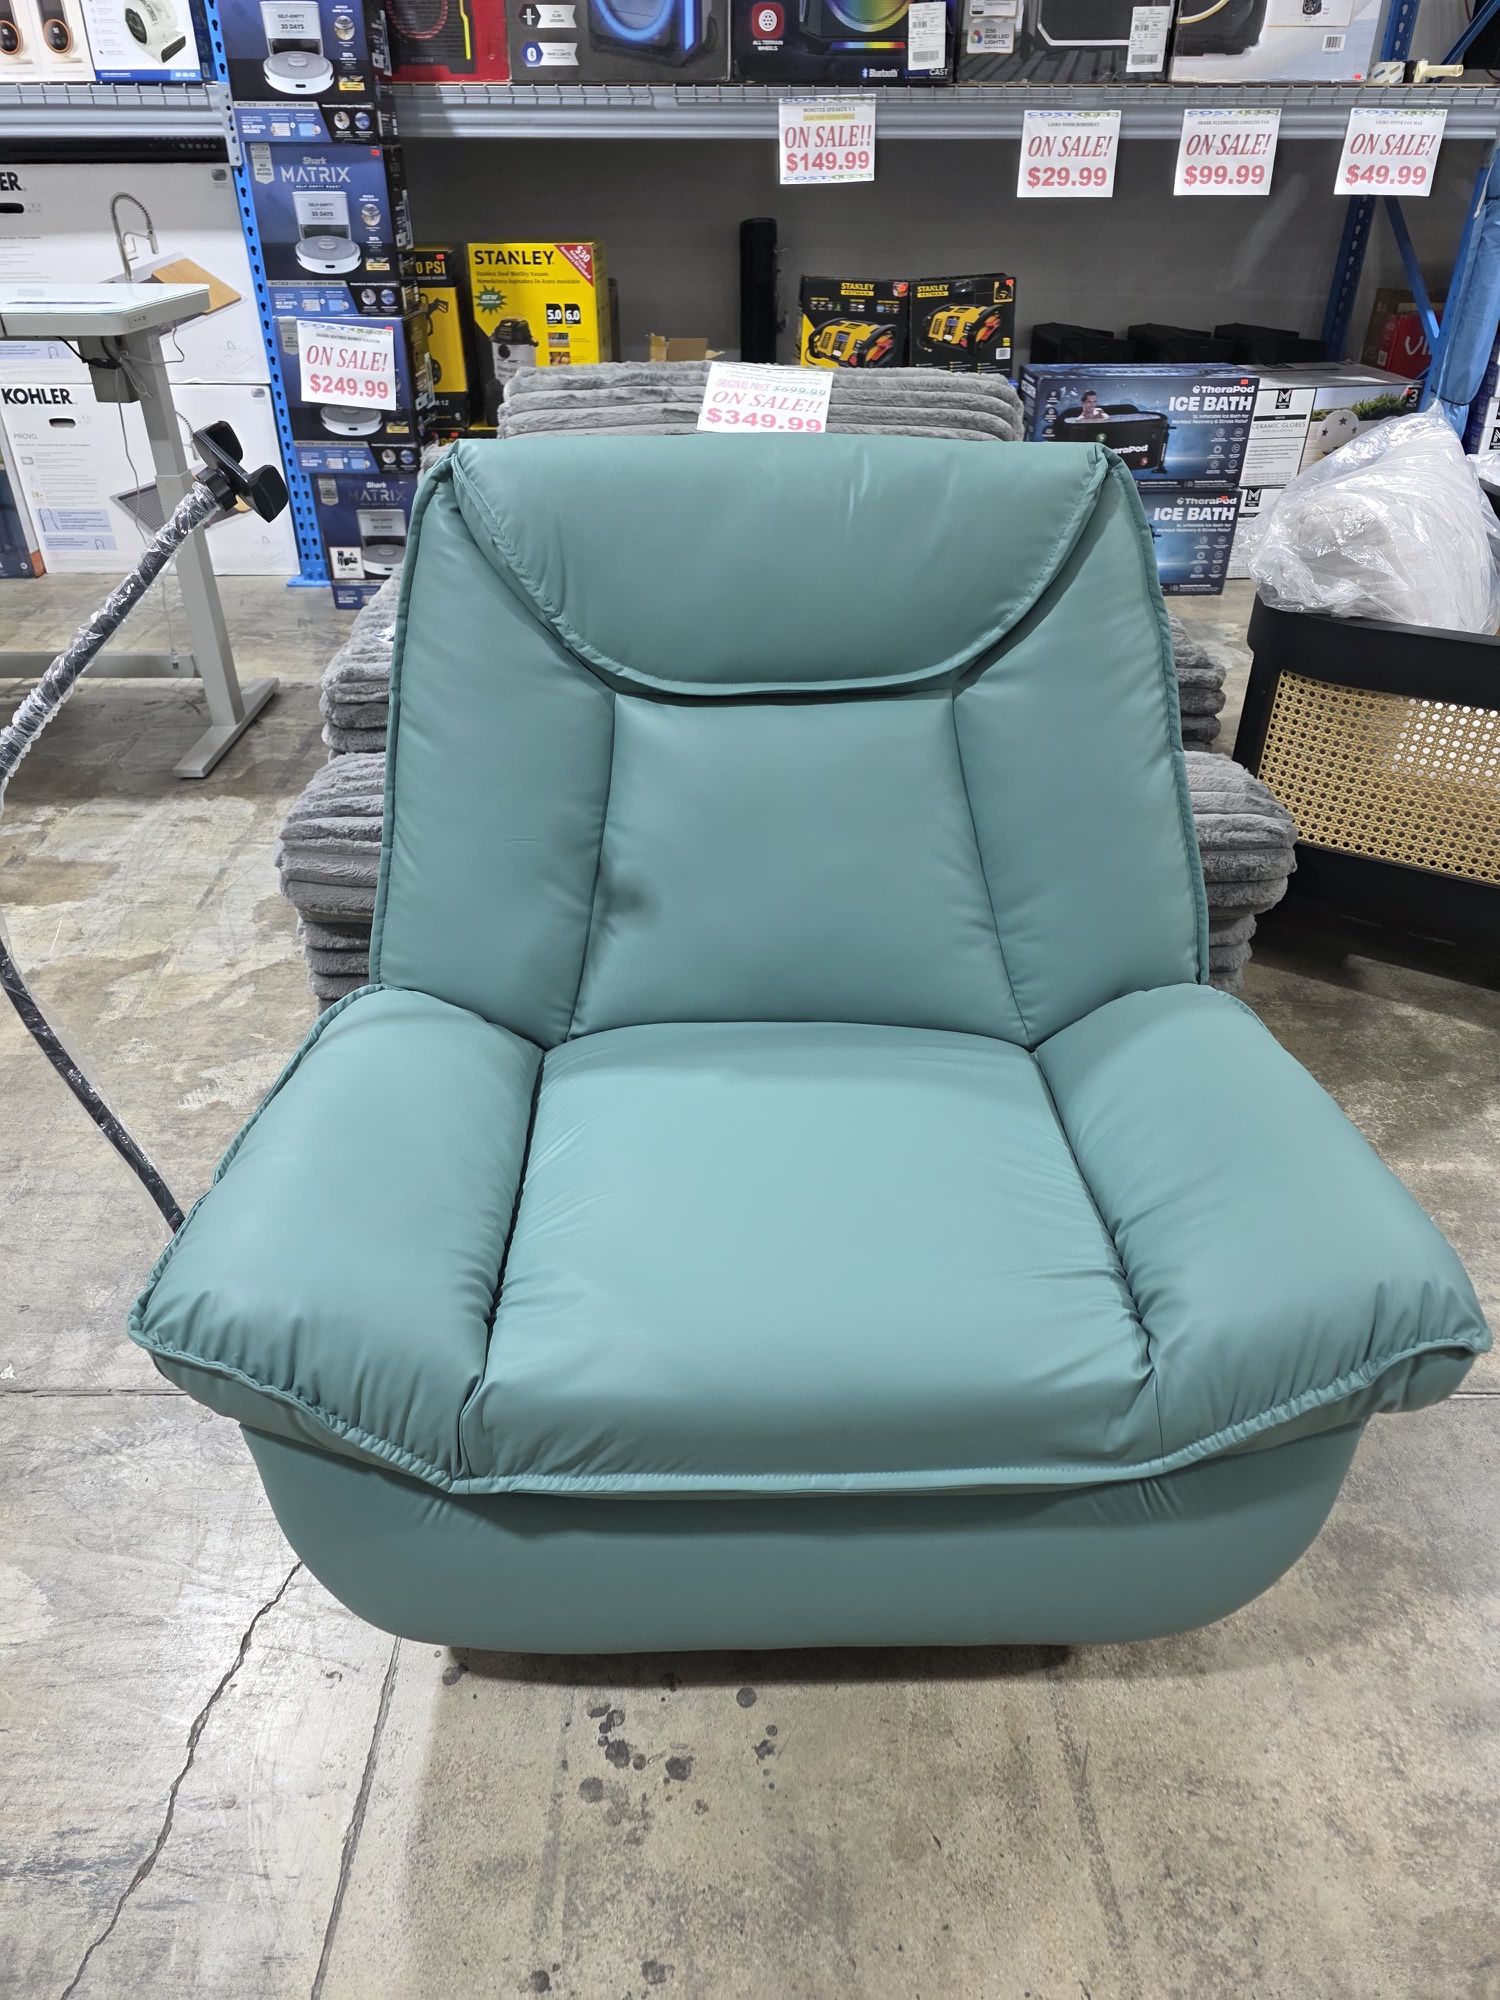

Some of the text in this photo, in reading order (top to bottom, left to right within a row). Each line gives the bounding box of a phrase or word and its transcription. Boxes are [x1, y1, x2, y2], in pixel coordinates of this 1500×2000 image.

[785, 124, 872, 149] ON SALE!!
[1185, 133, 1272, 156] ON SALE!
[1349, 133, 1437, 156] ON SALE!
[1028, 135, 1113, 158] ON SALE!
[303, 157, 327, 165] Shark
[786, 151, 870, 174] $149.99
[280, 166, 351, 183] MATRIX
[1026, 166, 1107, 190] $29.99
[1183, 165, 1265, 187] $99.99
[1344, 164, 1427, 186] $49.99
[474, 250, 555, 266] STANLEY
[425, 260, 446, 274] PSI
[841, 282, 875, 290] STANLEY
[917, 284, 950, 292] STANLEY
[546, 309, 562, 321] 5.0
[565, 309, 580, 321] 6.0
[1404, 335, 1432, 356] VI
[306, 345, 388, 373] ON SALE!
[310, 372, 389, 400] $249.99
[749, 380, 773, 392] PRICE
[1201, 385, 1255, 394] TheraPod
[1, 387, 74, 405] KOHLER
[711, 390, 824, 414] ON SALE!!
[1168, 396, 1253, 412] ICE BATH
[1409, 389, 1419, 403] 3
[705, 407, 822, 433] $349.99
[1251, 422, 1280, 430] CERAMIC
[366, 481, 387, 489] Shark
[1184, 497, 1238, 505] TheraPod
[1153, 507, 1236, 521] ICE BATH
